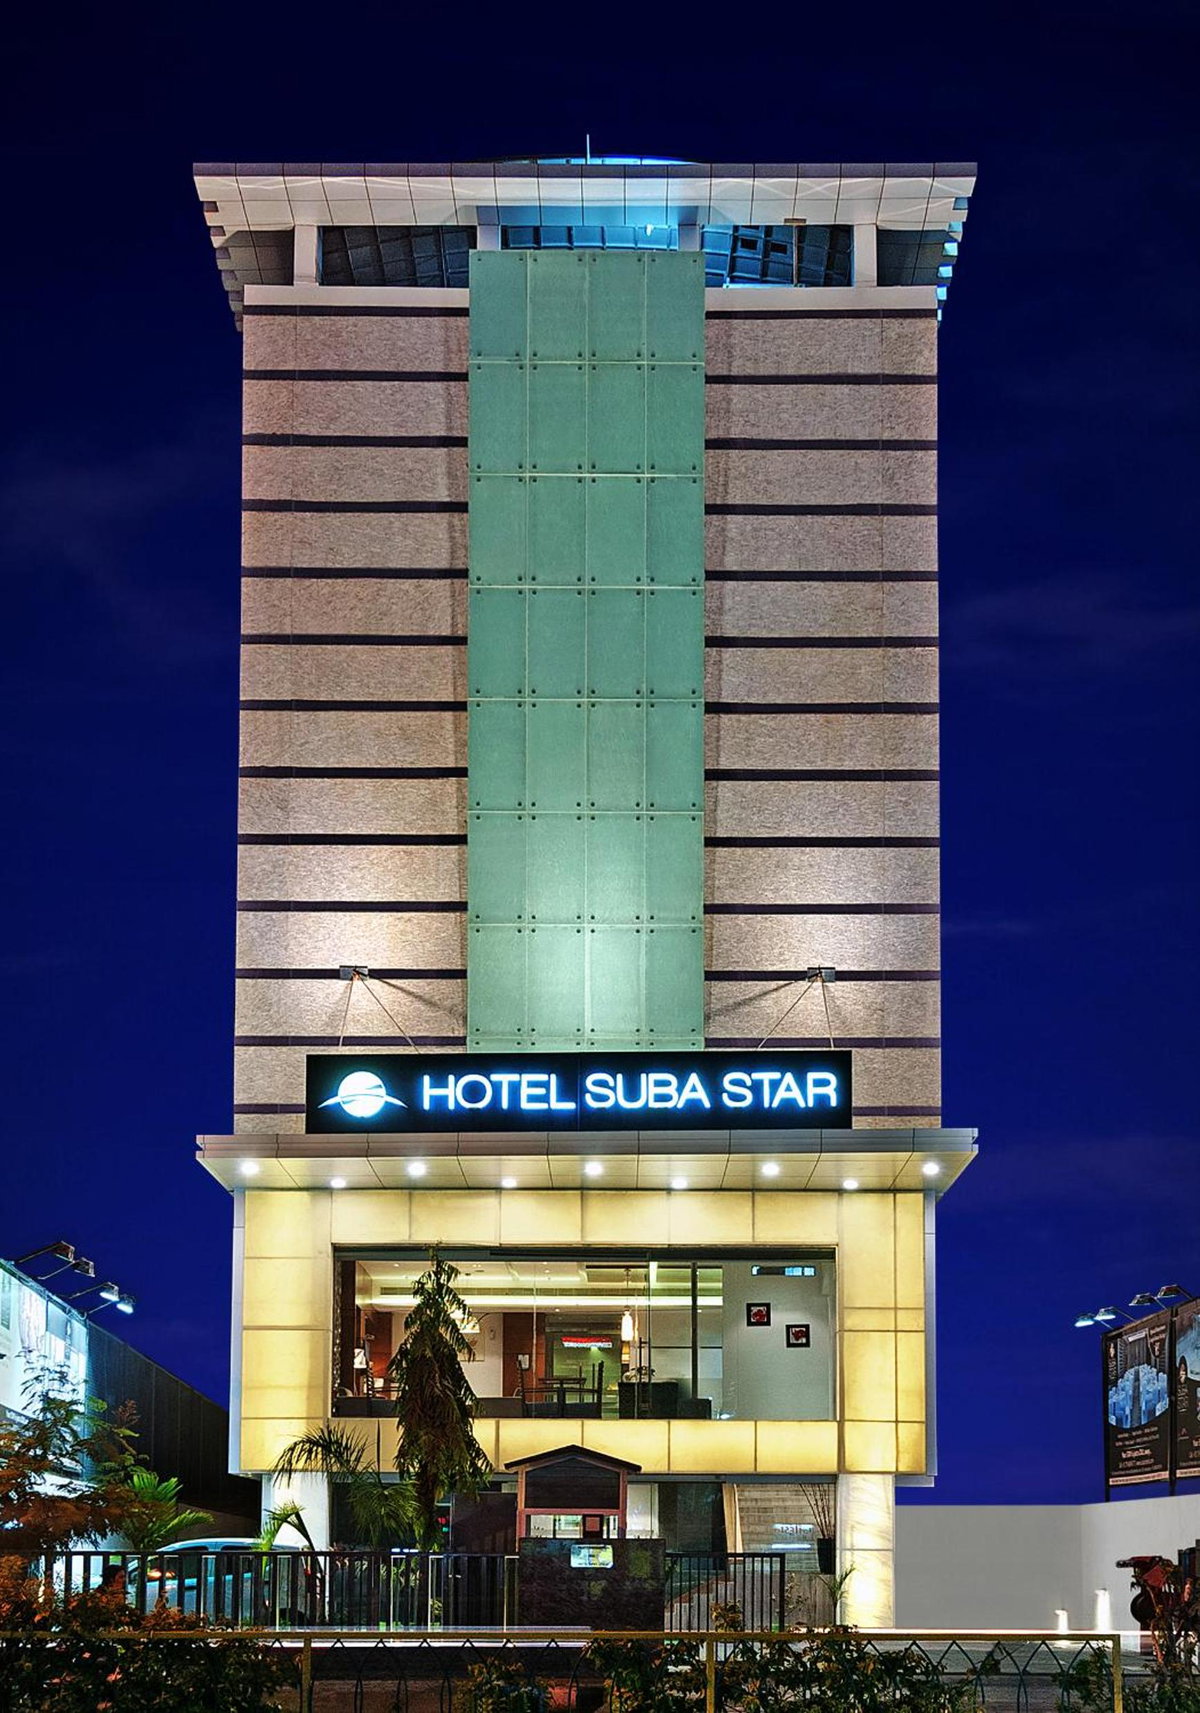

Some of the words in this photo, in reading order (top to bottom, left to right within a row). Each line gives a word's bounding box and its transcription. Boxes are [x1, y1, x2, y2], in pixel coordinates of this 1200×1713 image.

[421, 1073, 576, 1111] HOTEL
[584, 1072, 711, 1110] SUBA
[721, 1071, 838, 1108] STAR
